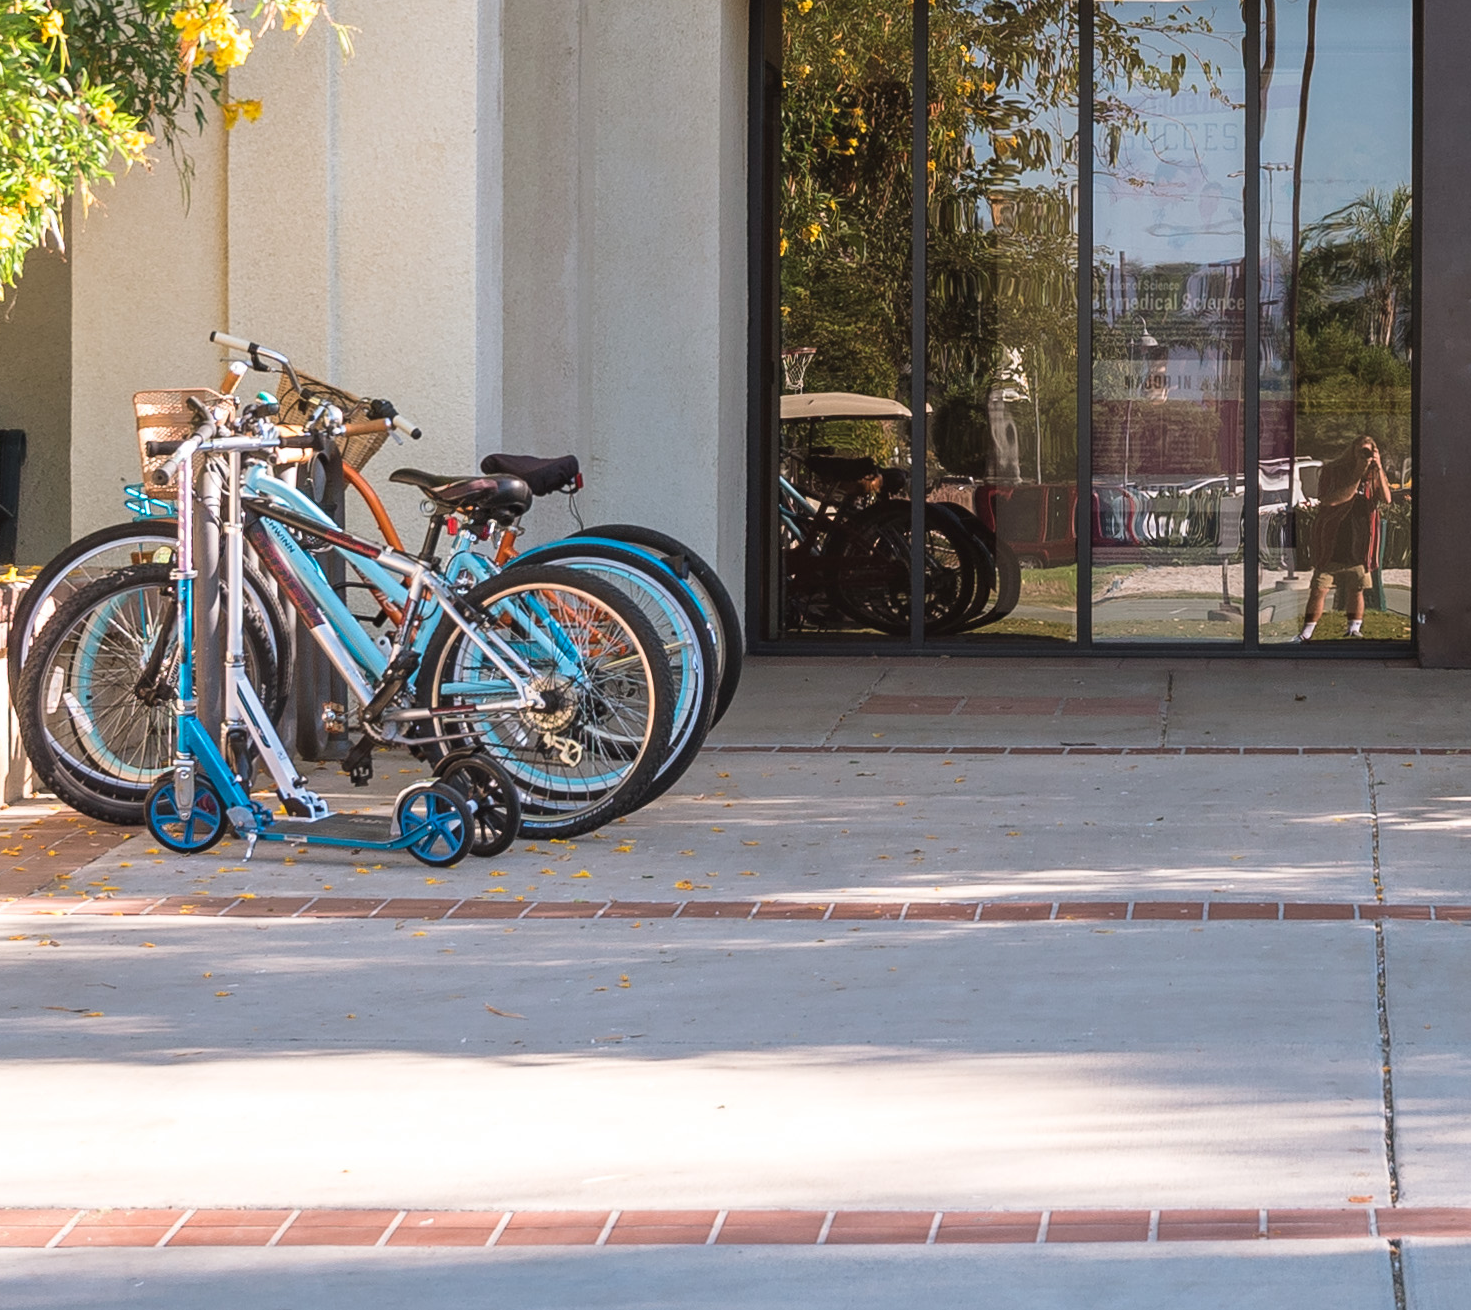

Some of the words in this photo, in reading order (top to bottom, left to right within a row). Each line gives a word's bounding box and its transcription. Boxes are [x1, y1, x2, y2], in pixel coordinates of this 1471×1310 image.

[1143, 280, 1181, 291] Science
[1093, 292, 1178, 311] Biomedical
[1177, 375, 1192, 390] IN
[264, 517, 296, 554] CHWINN
